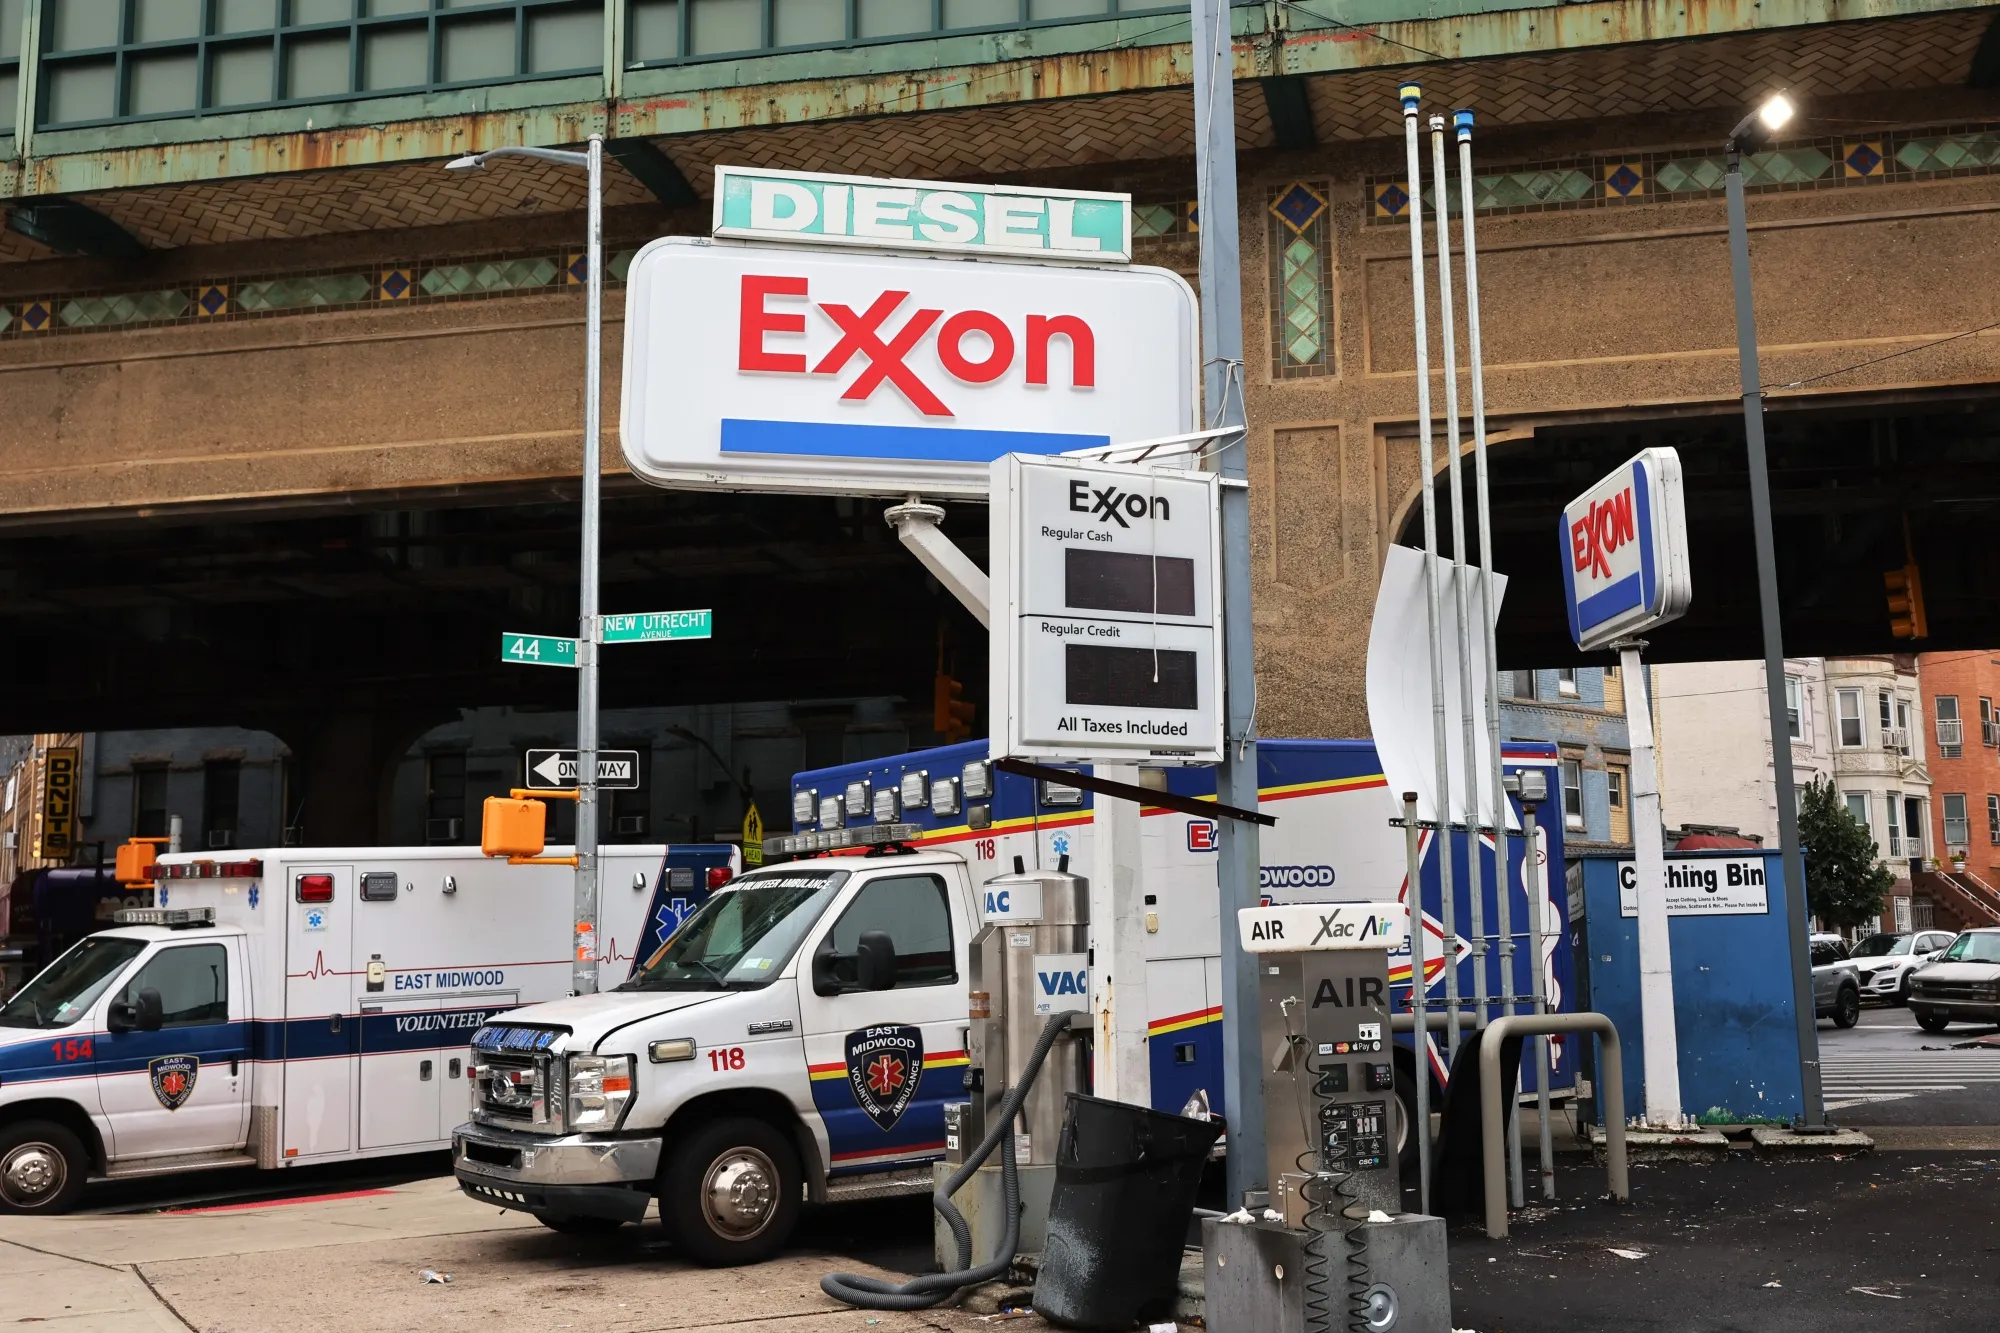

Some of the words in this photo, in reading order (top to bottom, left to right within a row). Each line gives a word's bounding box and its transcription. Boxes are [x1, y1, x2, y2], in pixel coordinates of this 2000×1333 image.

[750, 180, 1101, 251] DIESEL
[738, 274, 1095, 417] Exxon
[1069, 479, 1170, 529] Exxon
[1041, 526, 1085, 541] Regular
[1087, 530, 1113, 542] Cash
[1571, 486, 1634, 580] EXXON
[605, 616, 636, 632] NEW
[643, 612, 708, 630] UTRECHT
[1041, 622, 1085, 637] Regular
[1087, 625, 1121, 637] Credit
[640, 630, 672, 639] AVENUE
[509, 638, 541, 660] 44
[557, 642, 571, 653] ST
[1057, 717, 1077, 732] All
[1081, 718, 1123, 734] Taxes
[1127, 720, 1188, 736] Included
[558, 762, 577, 776] ON
[598, 762, 627, 777] WAY
[47, 758, 71, 848] DONUTS
[975, 839, 996, 860] 118
[779, 878, 833, 889] AMBULANCE
[1260, 867, 1335, 886] DWOOD
[1620, 865, 1718, 893] Ching
[1726, 863, 1765, 887] Bin
[1251, 920, 1285, 941] AIR
[1310, 908, 1355, 946] Xac
[395, 974, 433, 990] EAST
[436, 970, 504, 988] MIDWOOD
[1038, 970, 1087, 996] VAC
[1312, 976, 1386, 1009] AIR
[395, 1011, 486, 1032] VOLUNTEER
[866, 1026, 900, 1038] EAST
[51, 1038, 94, 1061] 154
[852, 1037, 916, 1056] MIDWOOD
[1358, 1042, 1370, 1052] Pay
[157, 1064, 191, 1072] MIDWOOD
[163, 1057, 184, 1065] EAST
[708, 1047, 745, 1072] 118
[152, 1074, 172, 1107] VOLUNTEER
[176, 1071, 197, 1106] AMBULANCE
[851, 1065, 881, 1118] VOLUNTEER
[892, 1059, 920, 1117] AMBULANCE
